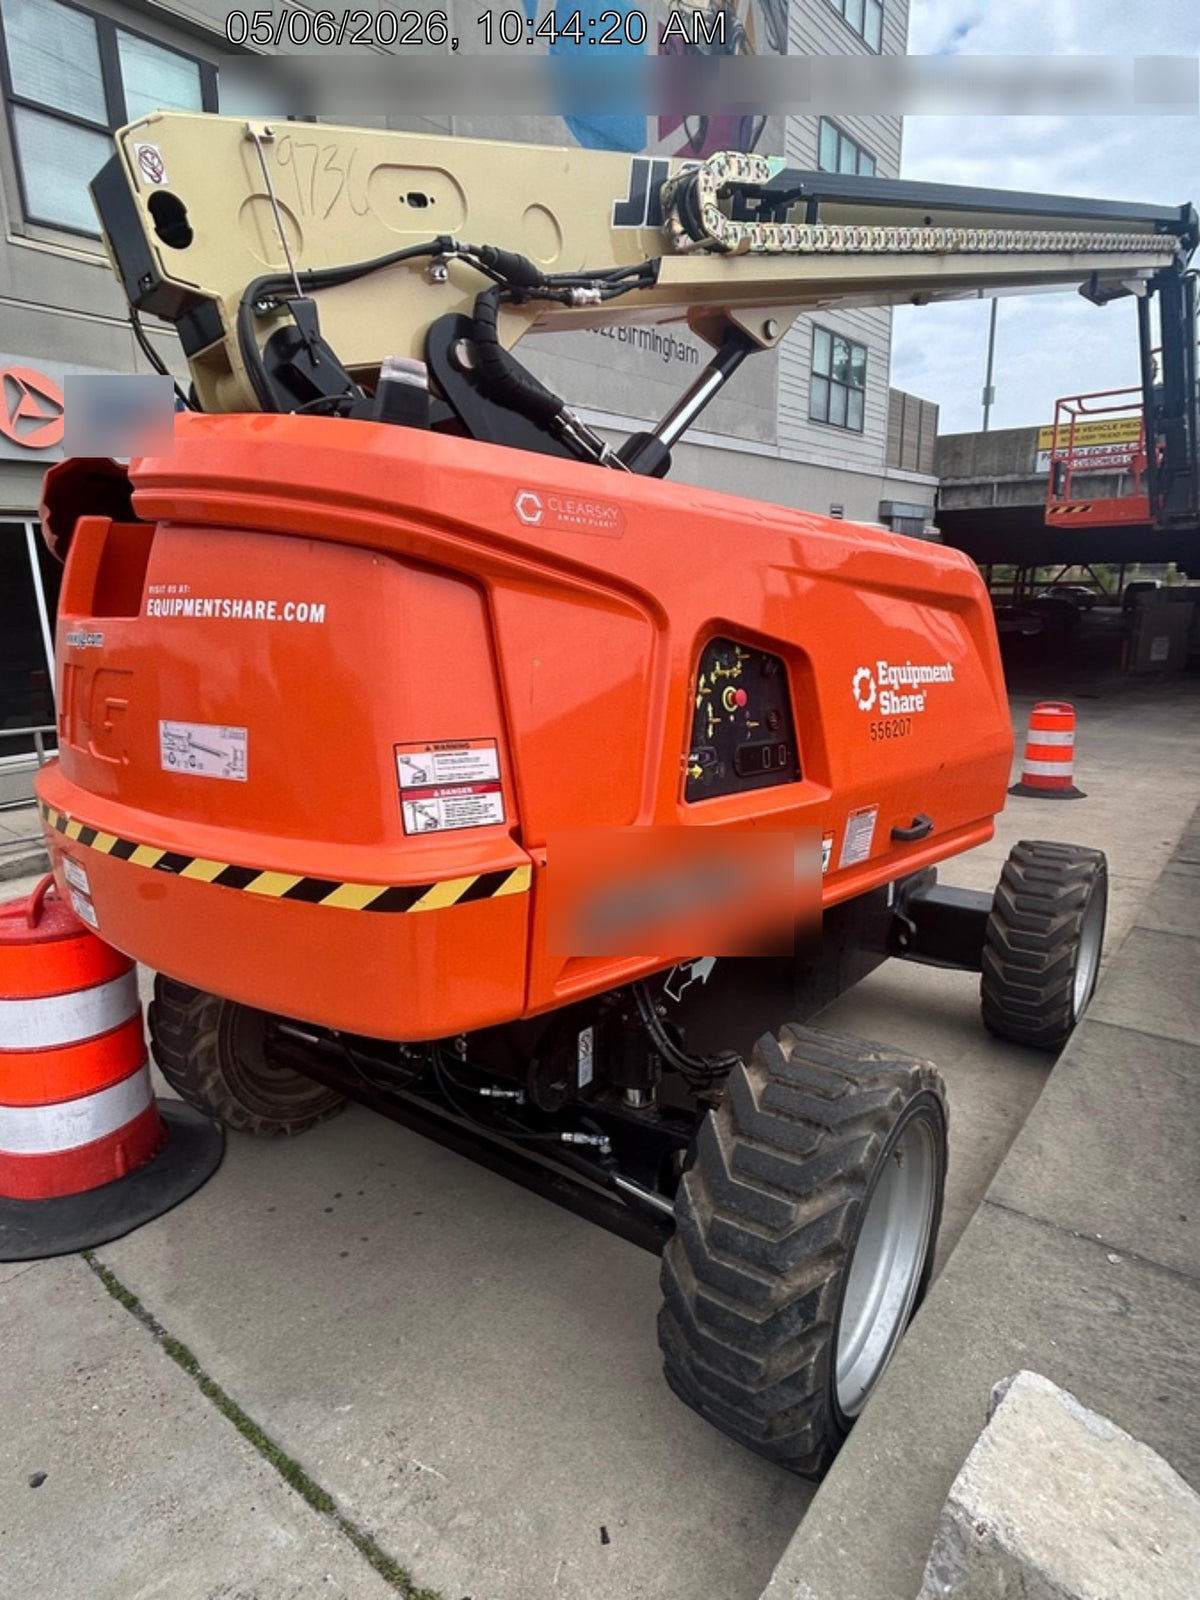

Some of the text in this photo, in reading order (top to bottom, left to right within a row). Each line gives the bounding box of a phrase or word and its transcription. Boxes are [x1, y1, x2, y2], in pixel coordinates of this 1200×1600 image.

[618, 326, 699, 364] Birmingham
[547, 496, 618, 519] CLEARSKY
[147, 598, 326, 623] EQUIPMENTSHARE.COM
[877, 660, 954, 689] Equipment
[869, 717, 912, 741] 556207
[441, 787, 473, 795] DANGER
